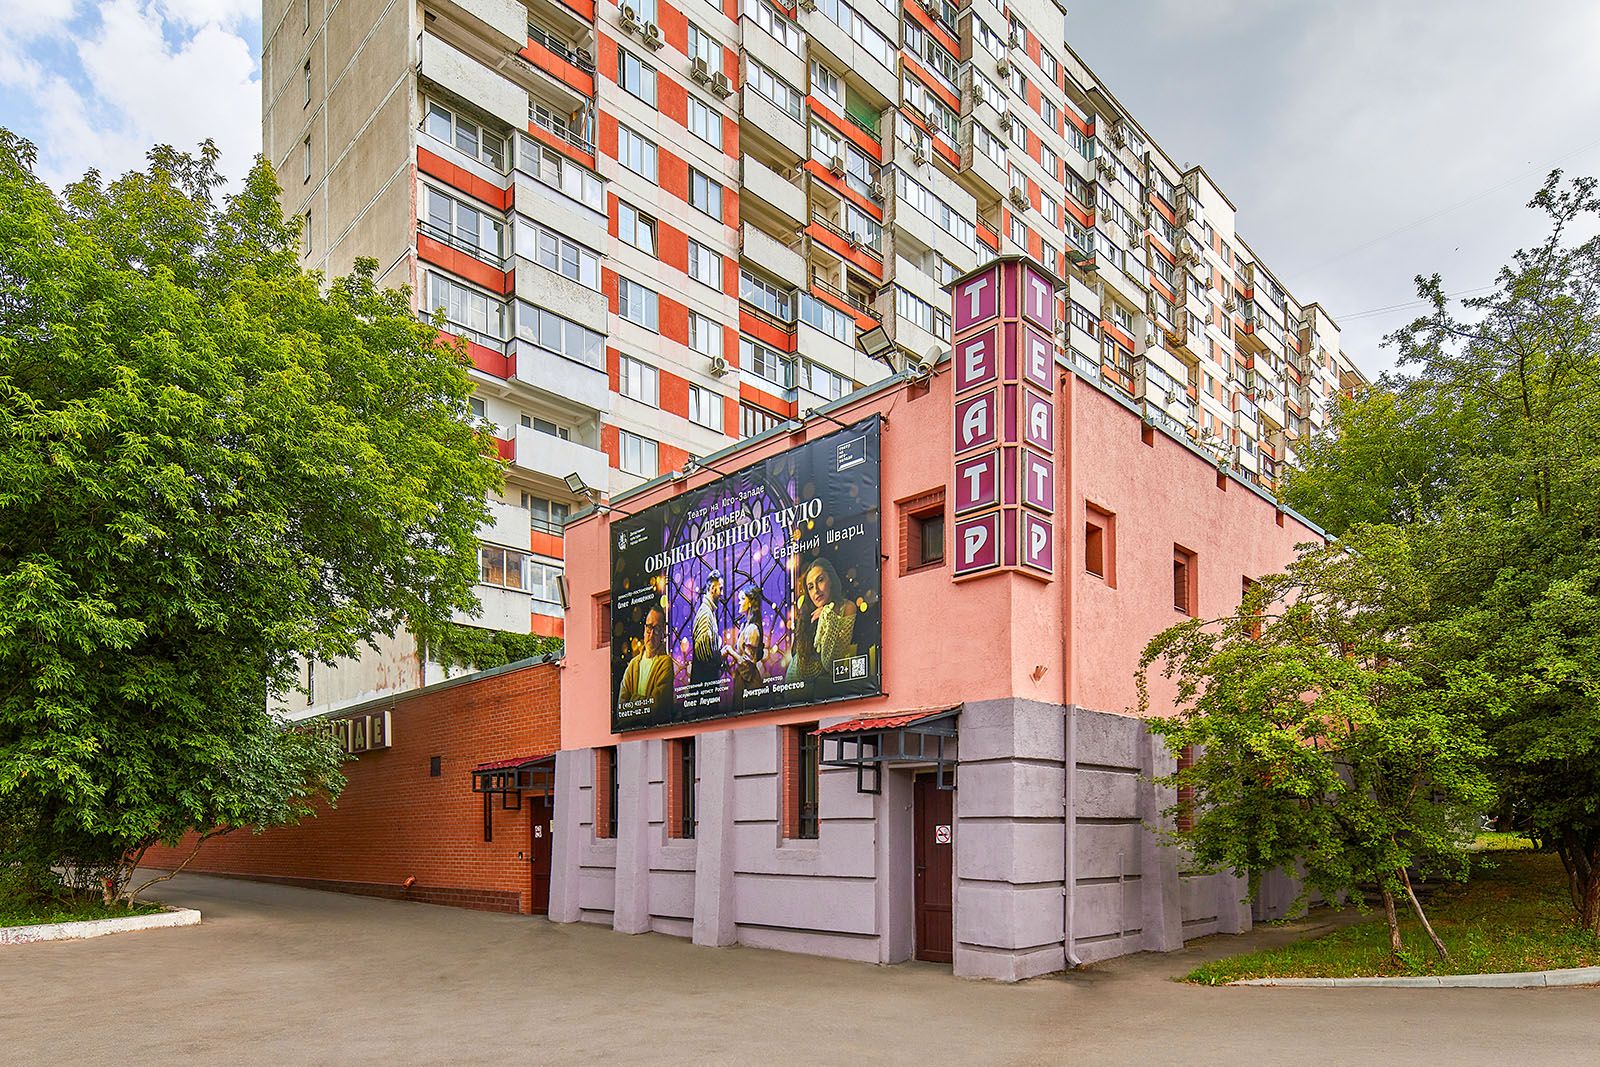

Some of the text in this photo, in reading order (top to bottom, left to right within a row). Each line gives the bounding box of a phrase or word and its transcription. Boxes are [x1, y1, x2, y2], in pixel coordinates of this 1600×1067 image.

[962, 277, 988, 564] ТЕАТР
[1030, 277, 1048, 560] ТЕАТР
[687, 485, 765, 521] Театр на Юго-Западе
[704, 508, 746, 532] ПРЕМЬЕРА
[644, 516, 772, 574] ОБЫКНОВЕННОЕ
[775, 498, 822, 529] ЧУДО
[773, 523, 865, 560] Евгений Шварц
[762, 675, 784, 684] директор
[835, 665, 849, 676] 12+
[683, 700, 698, 708] Олег
[742, 681, 805, 698] Дмитрий Берестов
